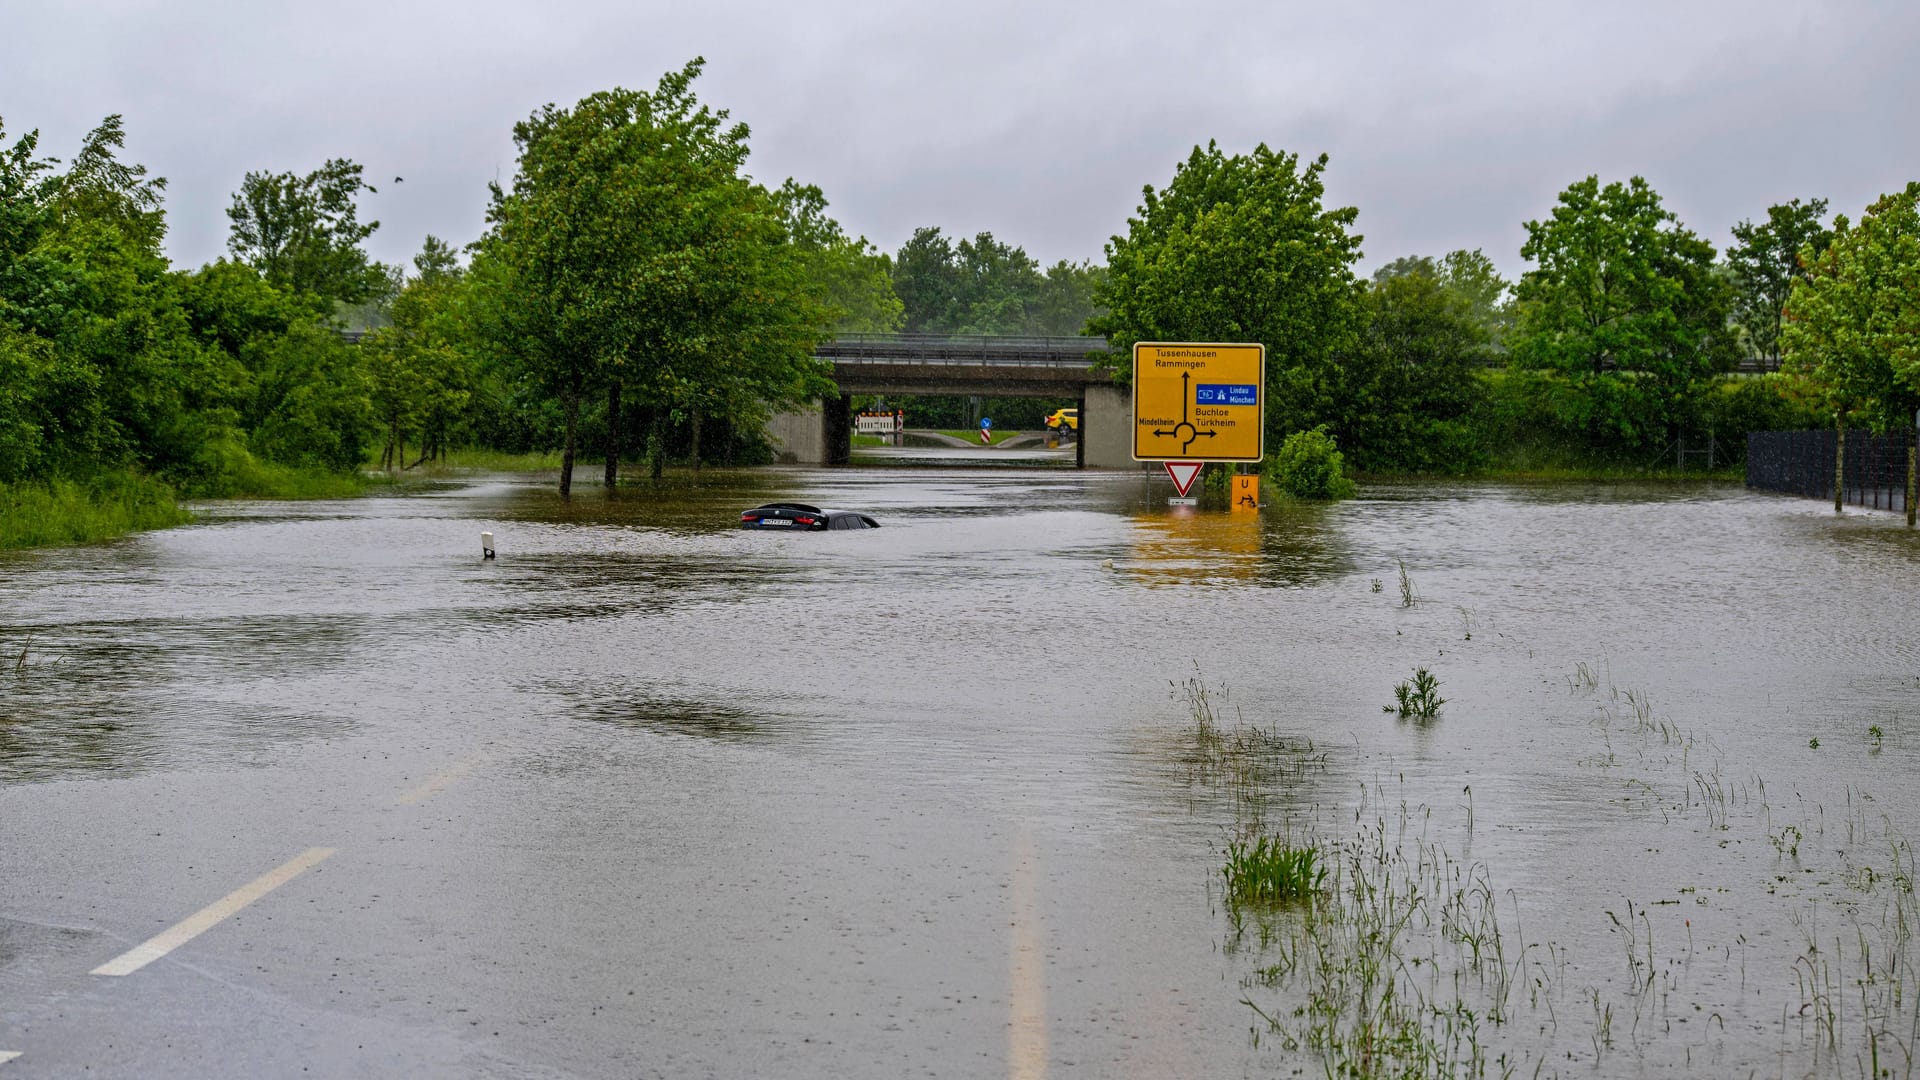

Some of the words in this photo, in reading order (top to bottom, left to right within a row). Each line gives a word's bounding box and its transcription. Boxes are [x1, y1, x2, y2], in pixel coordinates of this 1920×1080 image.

[1156, 349, 1217, 358] Tussenhausen
[1155, 360, 1205, 369] Rammingen
[1229, 386, 1249, 394] Lindau
[1229, 396, 1255, 404] München
[1195, 408, 1229, 416] Buchloe
[1138, 418, 1175, 426] Mindelheim
[1241, 479, 1249, 488] U
